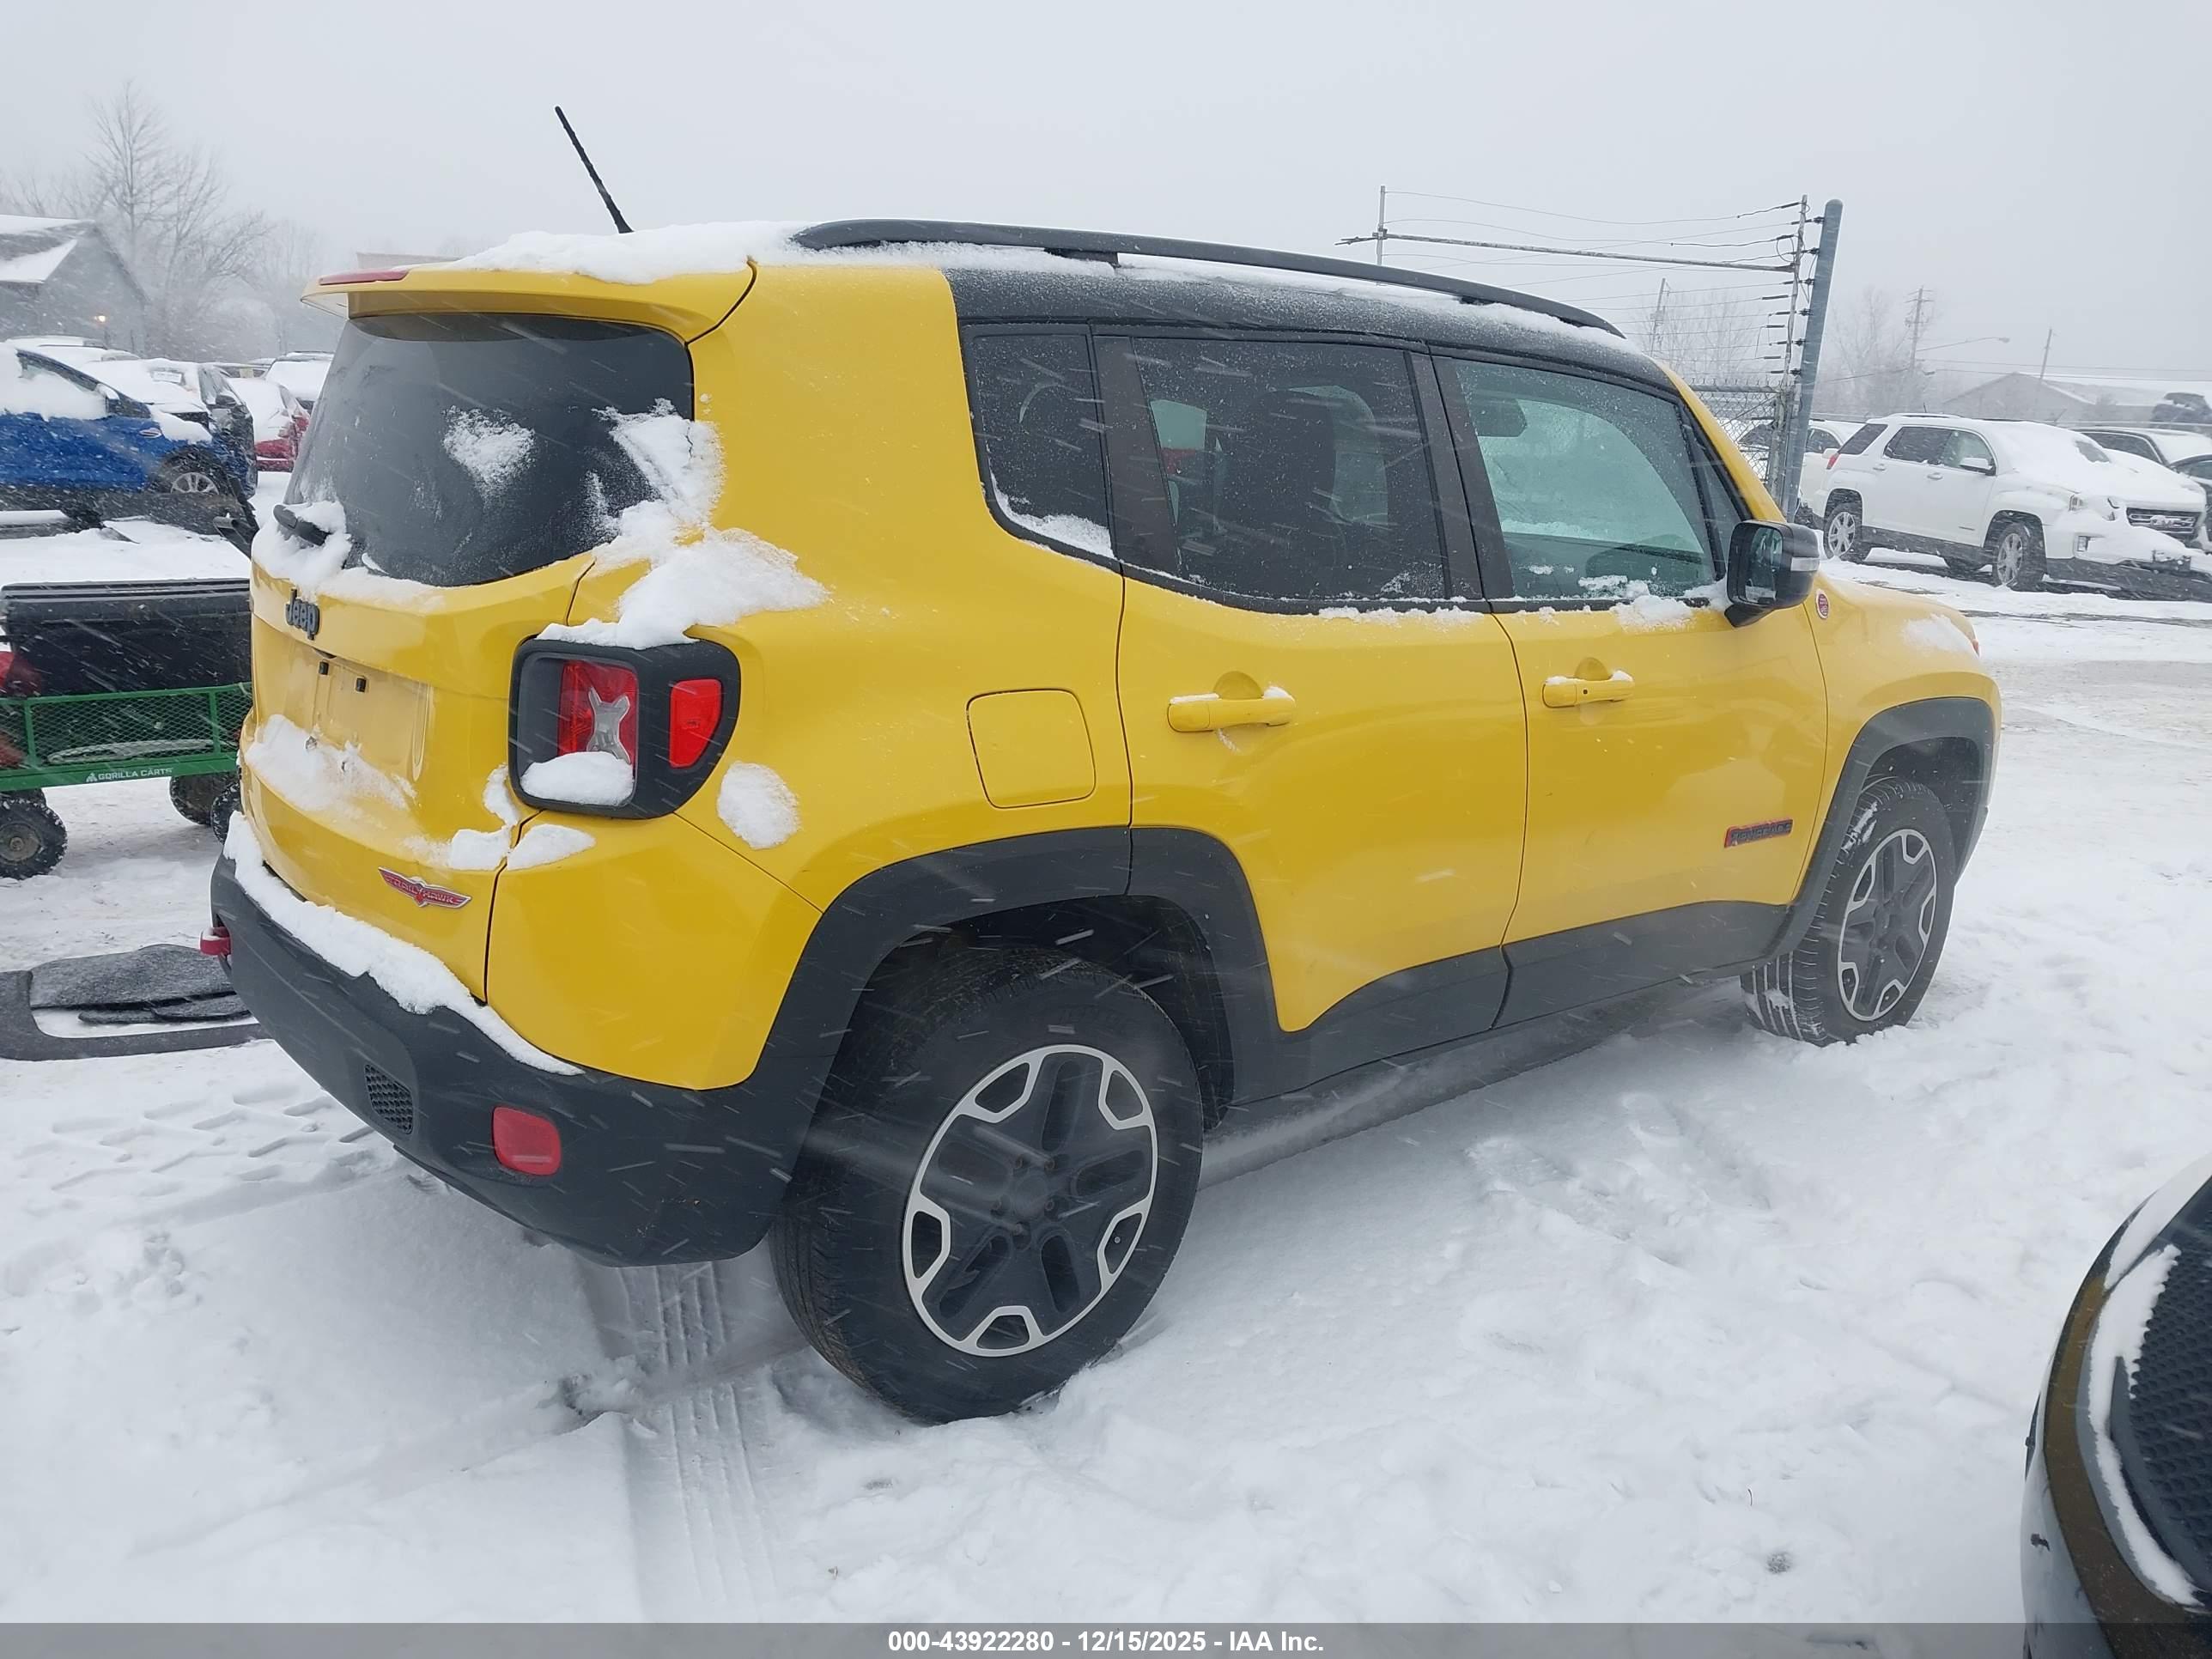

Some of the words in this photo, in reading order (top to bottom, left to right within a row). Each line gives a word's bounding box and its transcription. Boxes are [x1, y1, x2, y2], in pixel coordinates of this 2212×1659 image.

[285, 588, 319, 641] Jeep
[98, 771, 138, 781] GORILLA
[140, 768, 173, 776] CARTS
